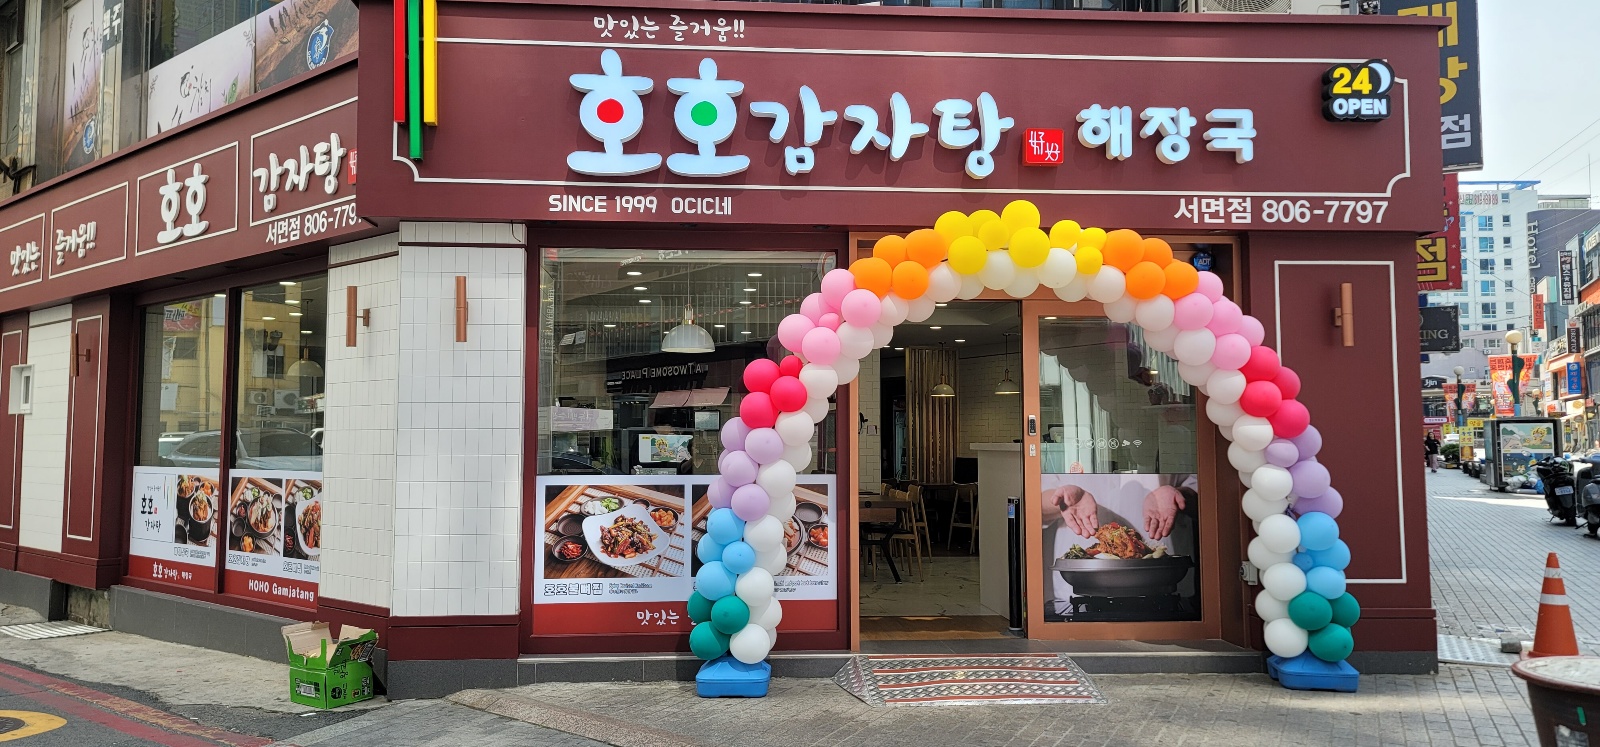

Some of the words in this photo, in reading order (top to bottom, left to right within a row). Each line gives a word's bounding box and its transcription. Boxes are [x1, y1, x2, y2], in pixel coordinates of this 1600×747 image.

[594, 15, 659, 39] 맛있는
[669, 15, 745, 42] 즐거움!!
[1332, 66, 1373, 96] 24
[1332, 98, 1388, 117] OPEN
[1076, 103, 1257, 165] 해장국
[253, 132, 347, 212] 감자탕
[157, 163, 210, 243] 호호
[548, 195, 606, 214] SINCE
[615, 196, 657, 214] 1999
[1174, 197, 1252, 224] 서면점
[1262, 199, 1389, 224] 806-7797
[265, 215, 300, 245] 서면점
[304, 203, 361, 236] 806-779
[10, 241, 40, 276] 맛있는
[55, 221, 96, 265] 즐거움!!
[1527, 220, 1541, 270] Hotel
[141, 493, 154, 515] 호호
[248, 579, 270, 593] HOHO
[272, 582, 315, 602] Gamjatang
[636, 609, 679, 626] 맛있는
